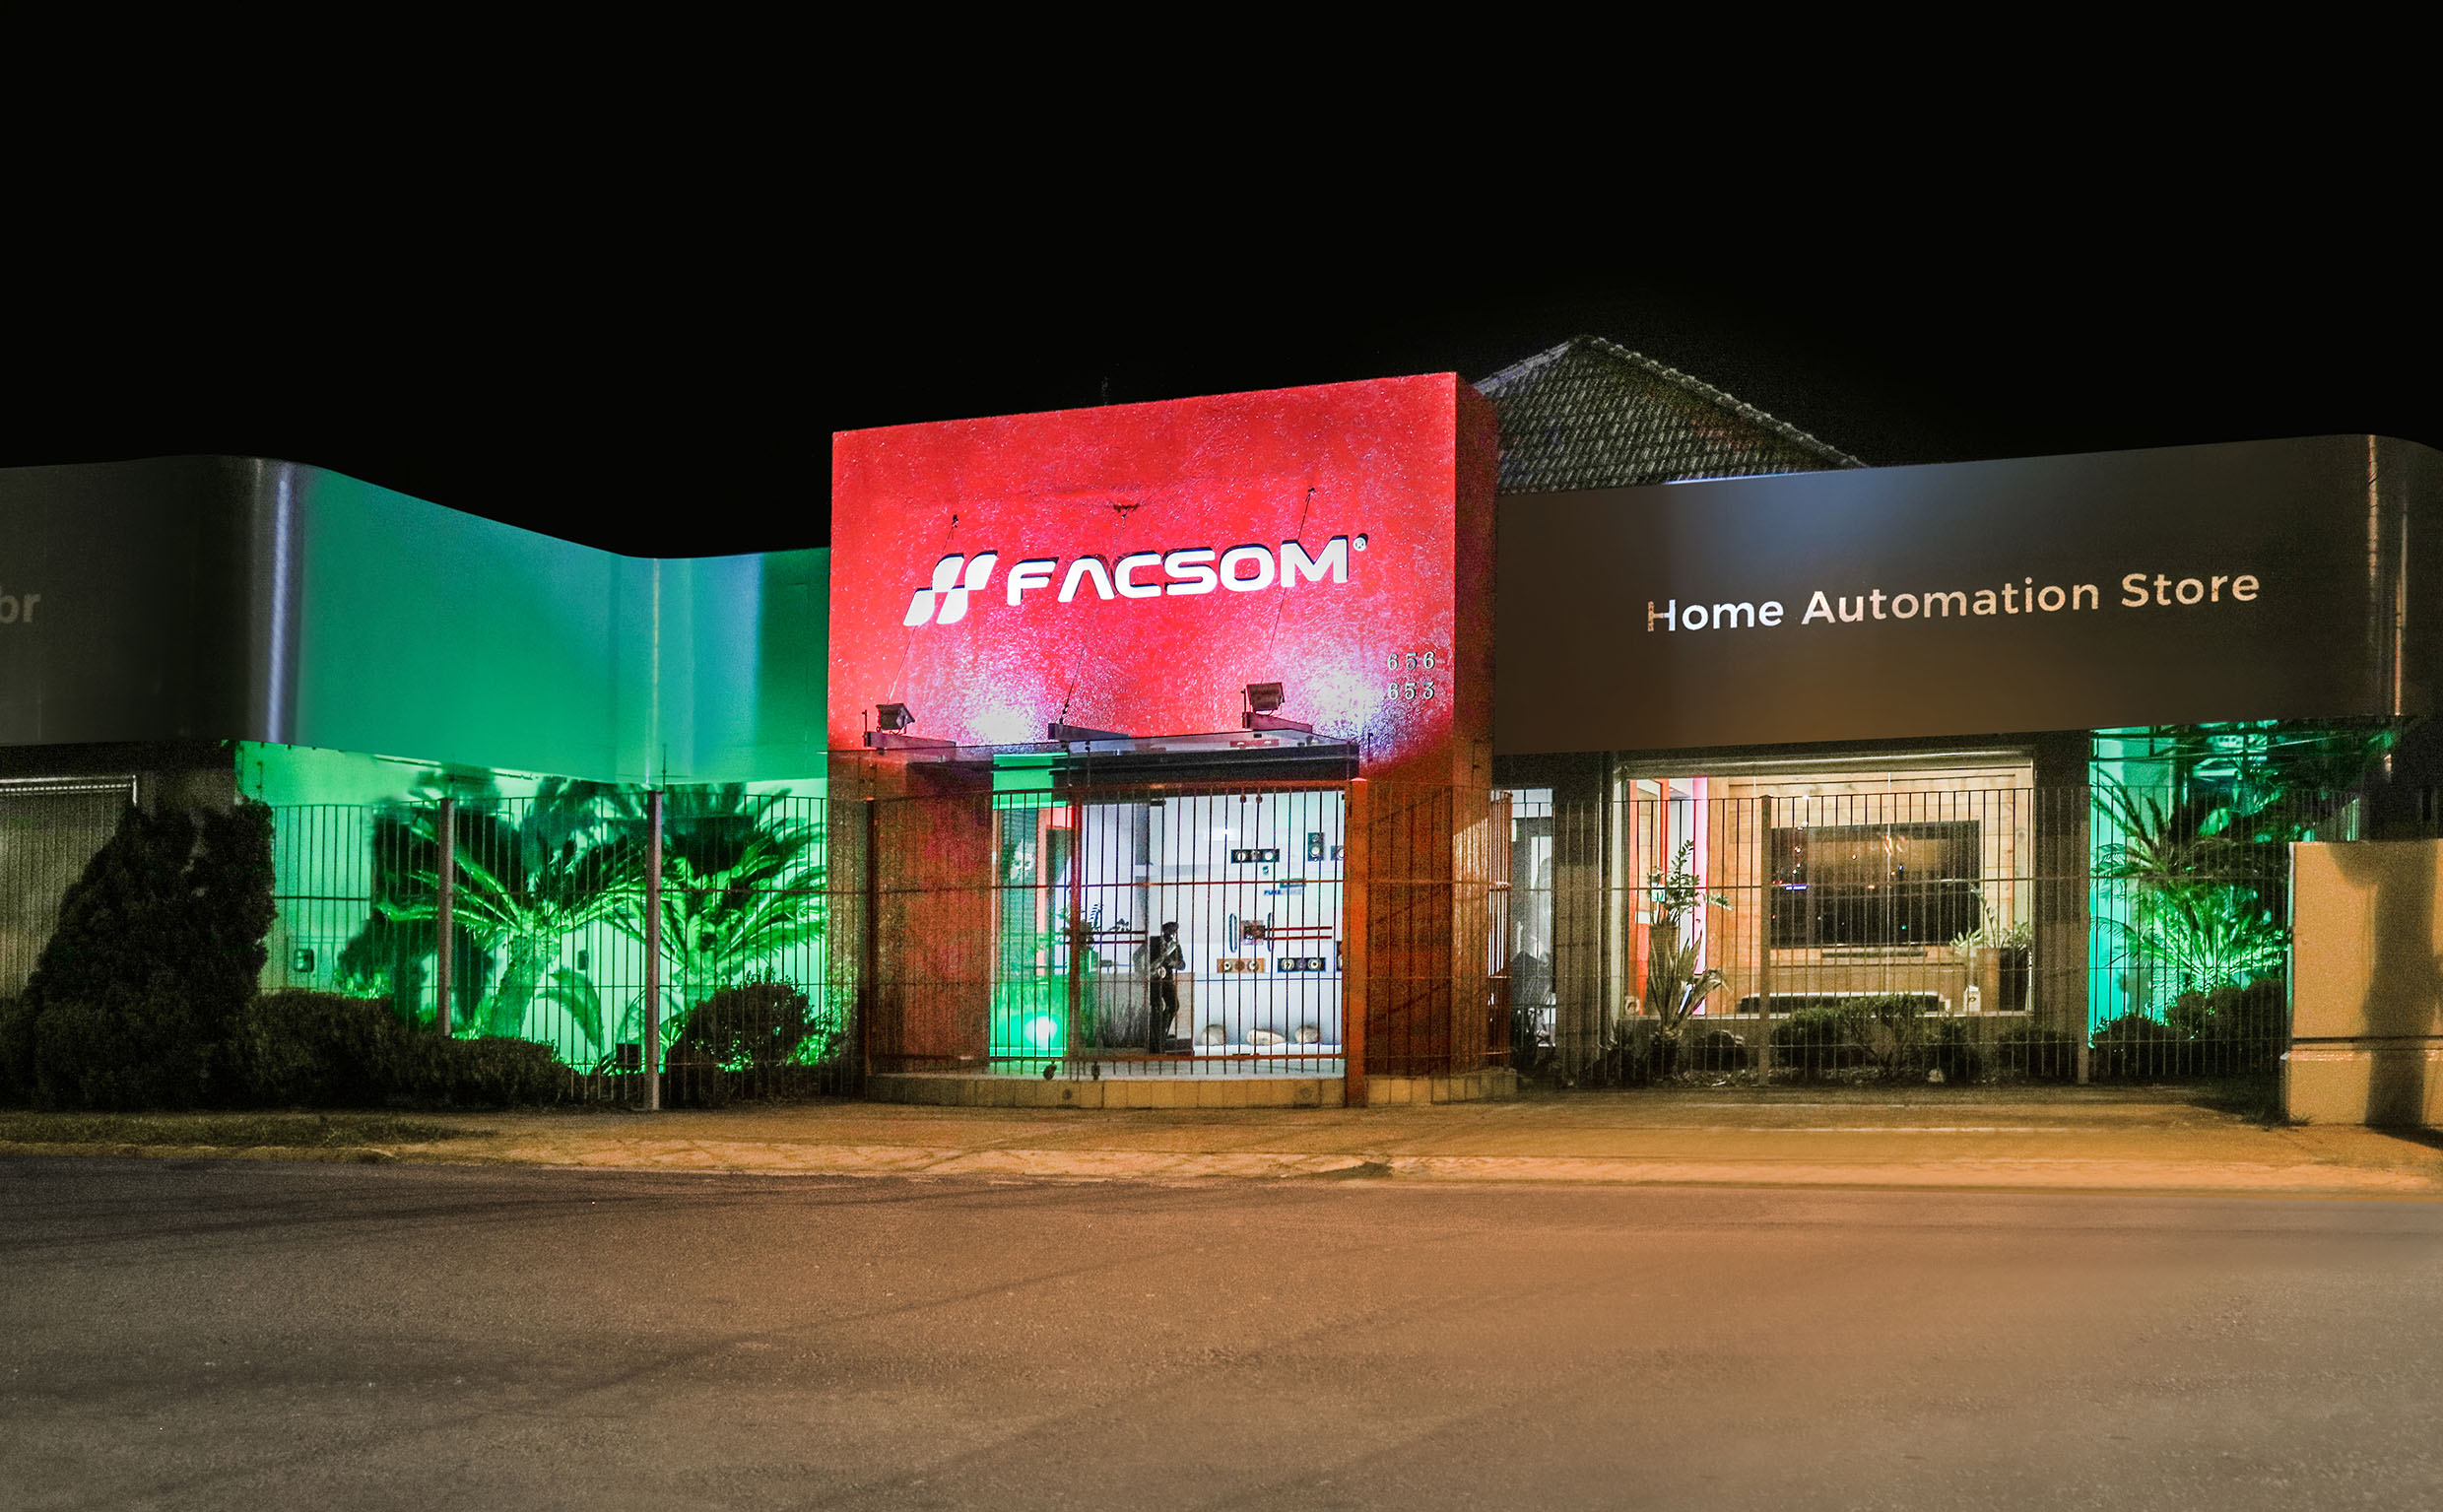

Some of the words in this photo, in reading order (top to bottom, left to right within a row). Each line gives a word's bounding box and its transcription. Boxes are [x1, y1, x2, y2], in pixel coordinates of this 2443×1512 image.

[1007, 535, 1350, 606] FACSOM
[1647, 598, 1784, 632] Home
[1801, 576, 2099, 625] Automation
[2121, 572, 2260, 608] Store
[1387, 651, 1435, 671] 656
[1388, 682, 1434, 700] 653
